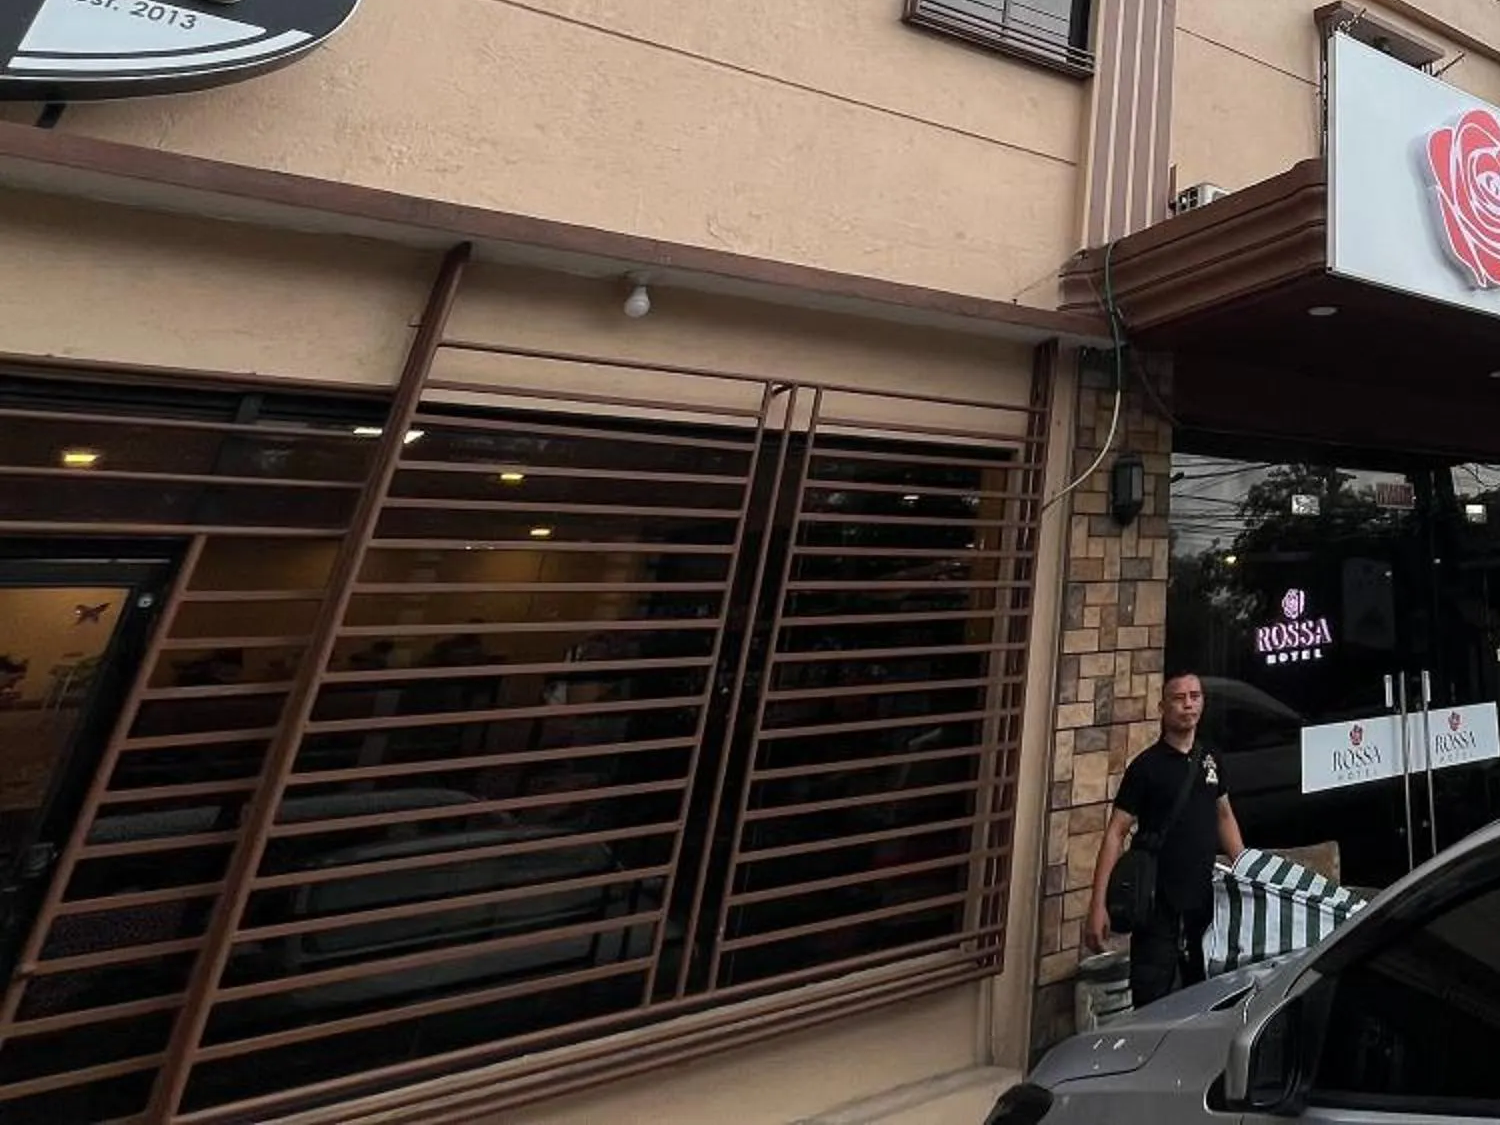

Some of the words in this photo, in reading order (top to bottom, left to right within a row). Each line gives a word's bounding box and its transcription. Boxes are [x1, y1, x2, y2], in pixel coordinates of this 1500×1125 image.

[130, 1, 197, 30] 2013
[1257, 618, 1332, 651] ROSSA
[1435, 730, 1477, 755] ROSSA
[1332, 744, 1382, 772] ROSSA
